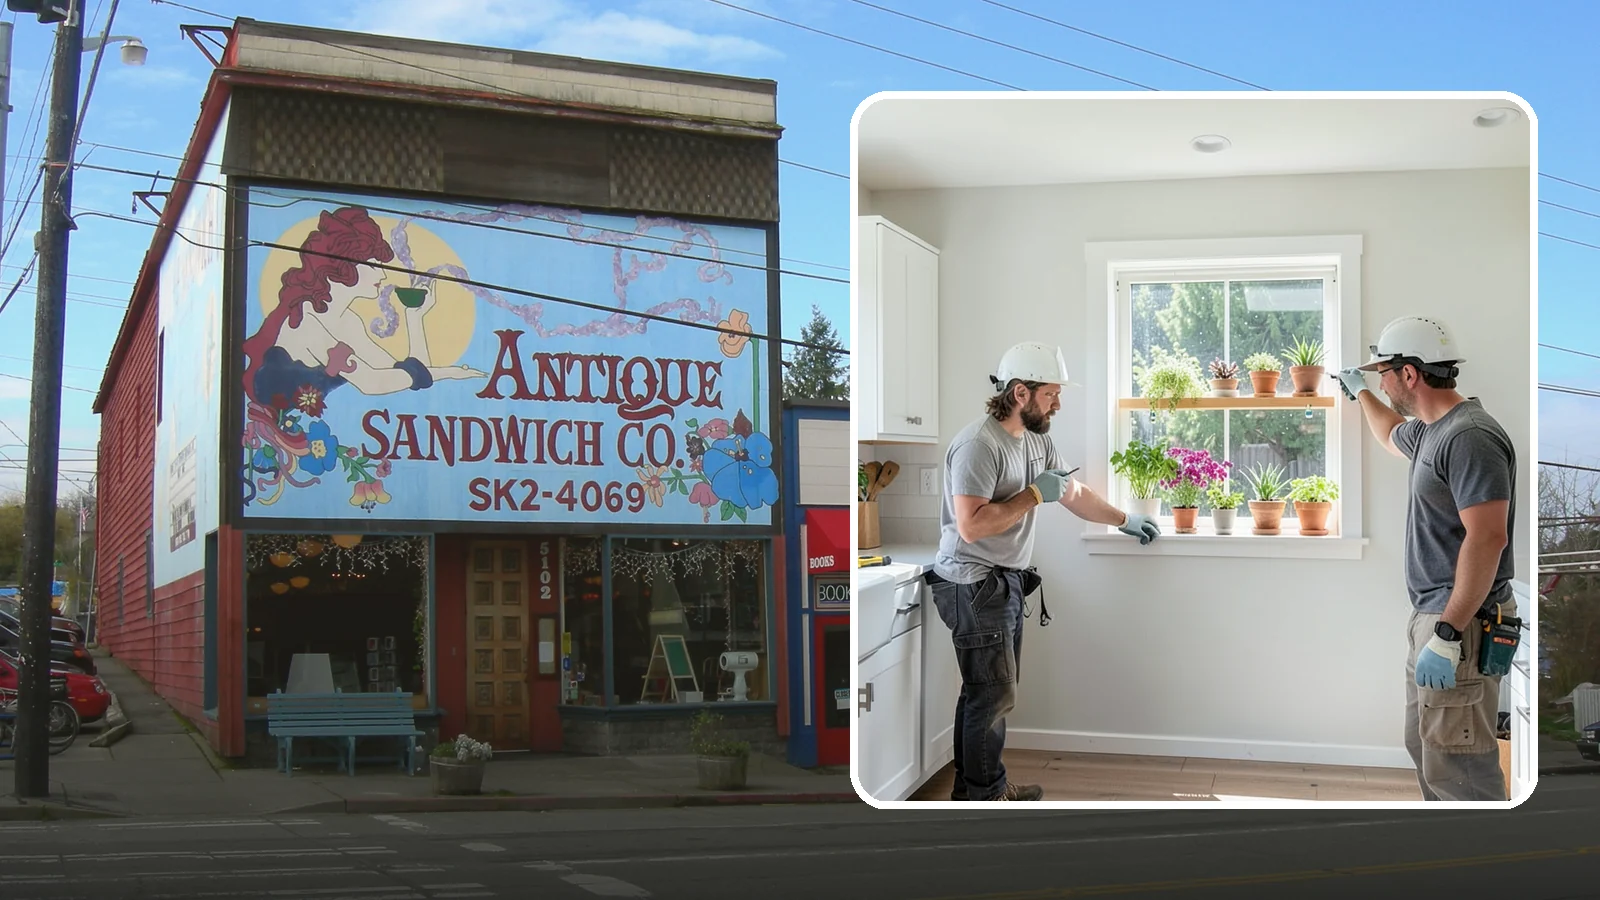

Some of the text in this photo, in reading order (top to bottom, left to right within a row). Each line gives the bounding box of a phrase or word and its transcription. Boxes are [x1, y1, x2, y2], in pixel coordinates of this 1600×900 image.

[477, 330, 723, 420] ANTIQUE
[362, 408, 686, 467] SANDWICH CO.
[468, 477, 645, 512] SK2-4069
[540, 542, 552, 600] 5102
[809, 555, 834, 569] BOOKS
